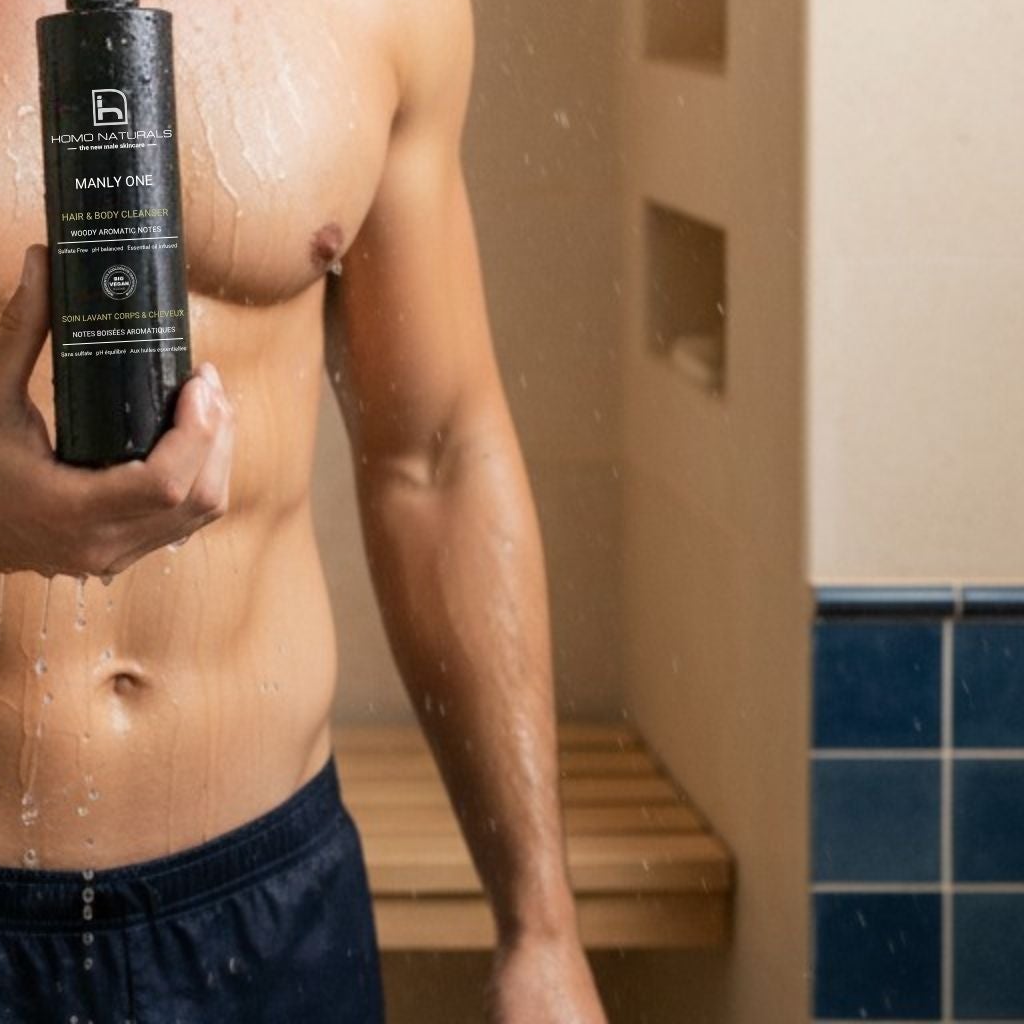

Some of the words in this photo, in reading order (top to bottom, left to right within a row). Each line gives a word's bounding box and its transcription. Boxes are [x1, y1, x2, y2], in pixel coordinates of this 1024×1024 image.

[51, 133, 93, 144] HOMO
[97, 129, 173, 141] NATURALS
[75, 176, 122, 190] MANLY
[125, 175, 153, 187] ONE
[62, 211, 84, 222] HAIR
[86, 211, 92, 220] &
[94, 210, 119, 220] BODY
[121, 208, 169, 219] CLEANSER
[71, 228, 97, 237] WOODY
[99, 227, 136, 236] AROMATIC
[82, 314, 112, 322] LAVANT
[149, 309, 184, 318] CHEVEUX
[96, 328, 125, 337] BOISÉES
[126, 326, 176, 335] AROMATIQUES
